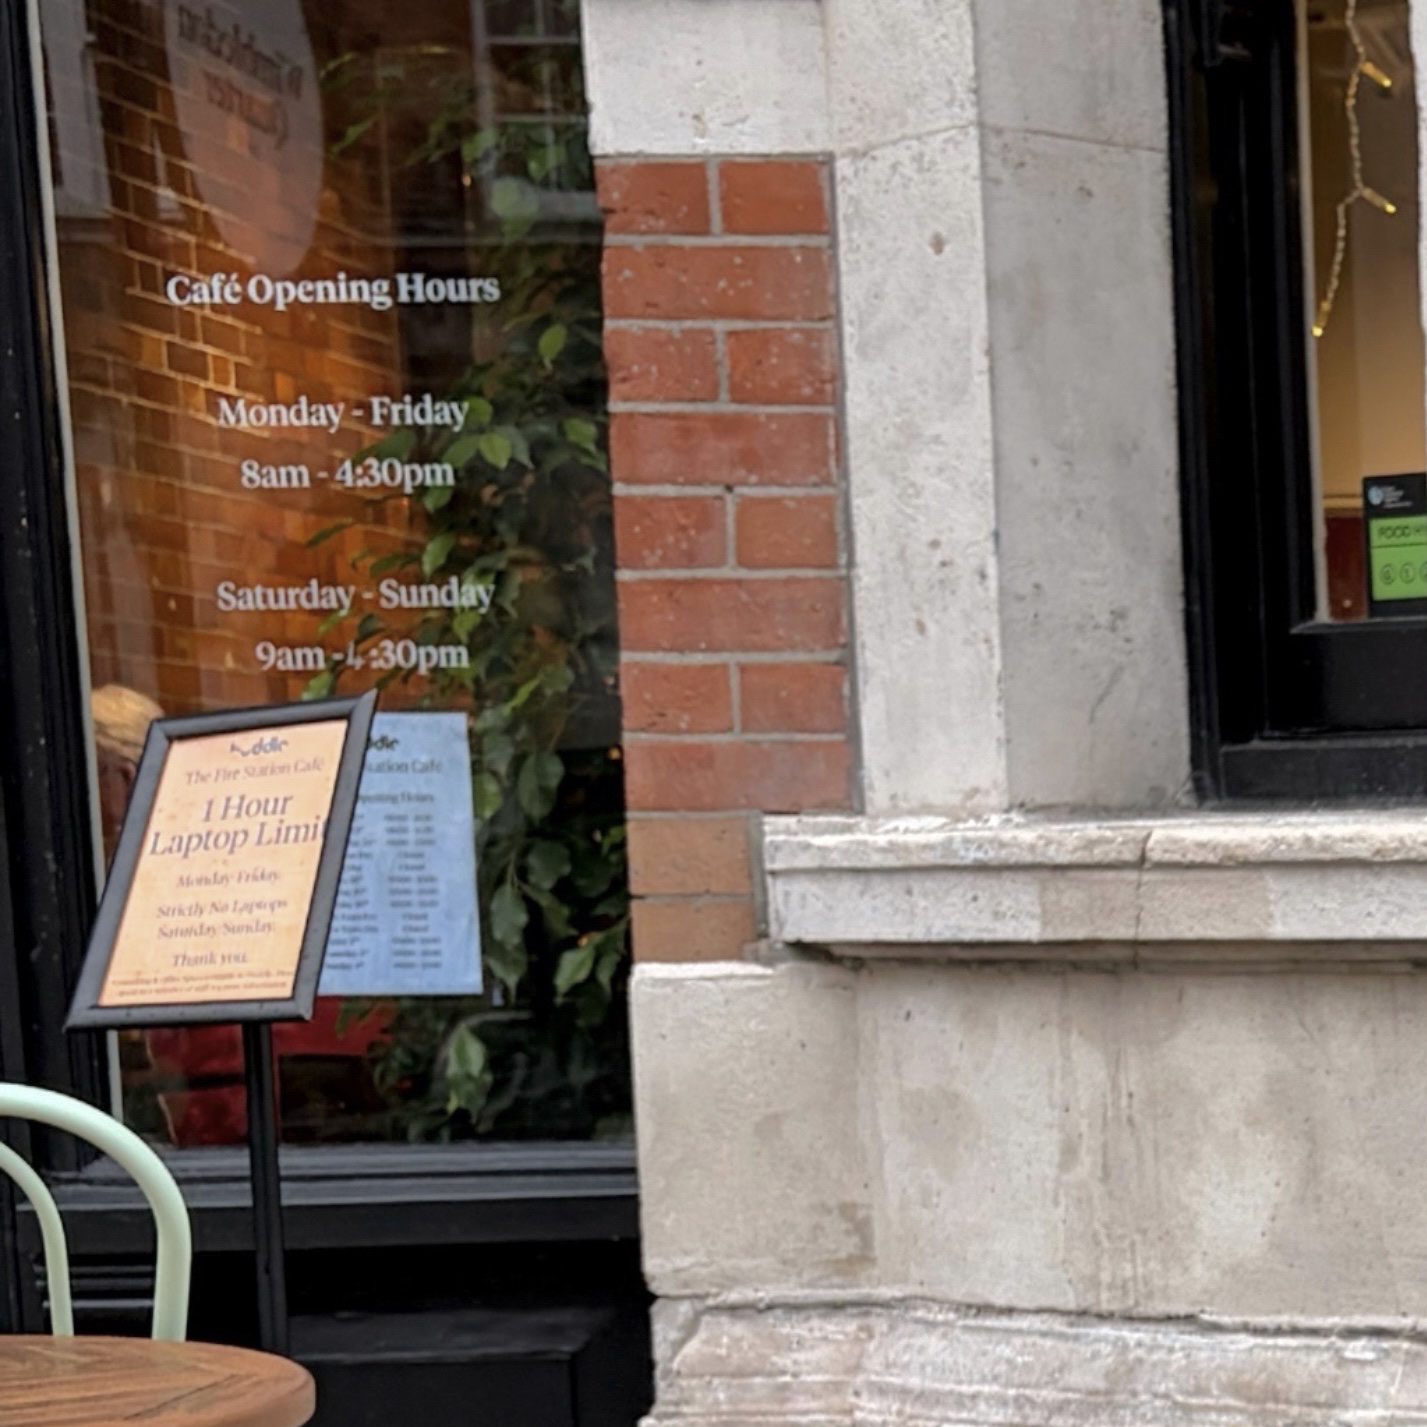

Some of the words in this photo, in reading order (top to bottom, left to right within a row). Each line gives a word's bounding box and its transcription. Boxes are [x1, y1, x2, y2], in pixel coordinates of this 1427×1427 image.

[167, 272, 242, 305] Café
[248, 272, 393, 311] Opening
[396, 273, 500, 304] Hours
[218, 395, 345, 433] Monday
[369, 393, 469, 432] Friday
[240, 459, 310, 489] 8am
[335, 457, 455, 494] 4:30pm
[217, 578, 355, 617] Saturday
[379, 575, 495, 614] Sunday
[255, 641, 326, 671] 9am
[186, 771, 212, 785] The
[221, 794, 293, 821] Hour
[150, 829, 249, 859] Laptop
[256, 815, 326, 847] Limi
